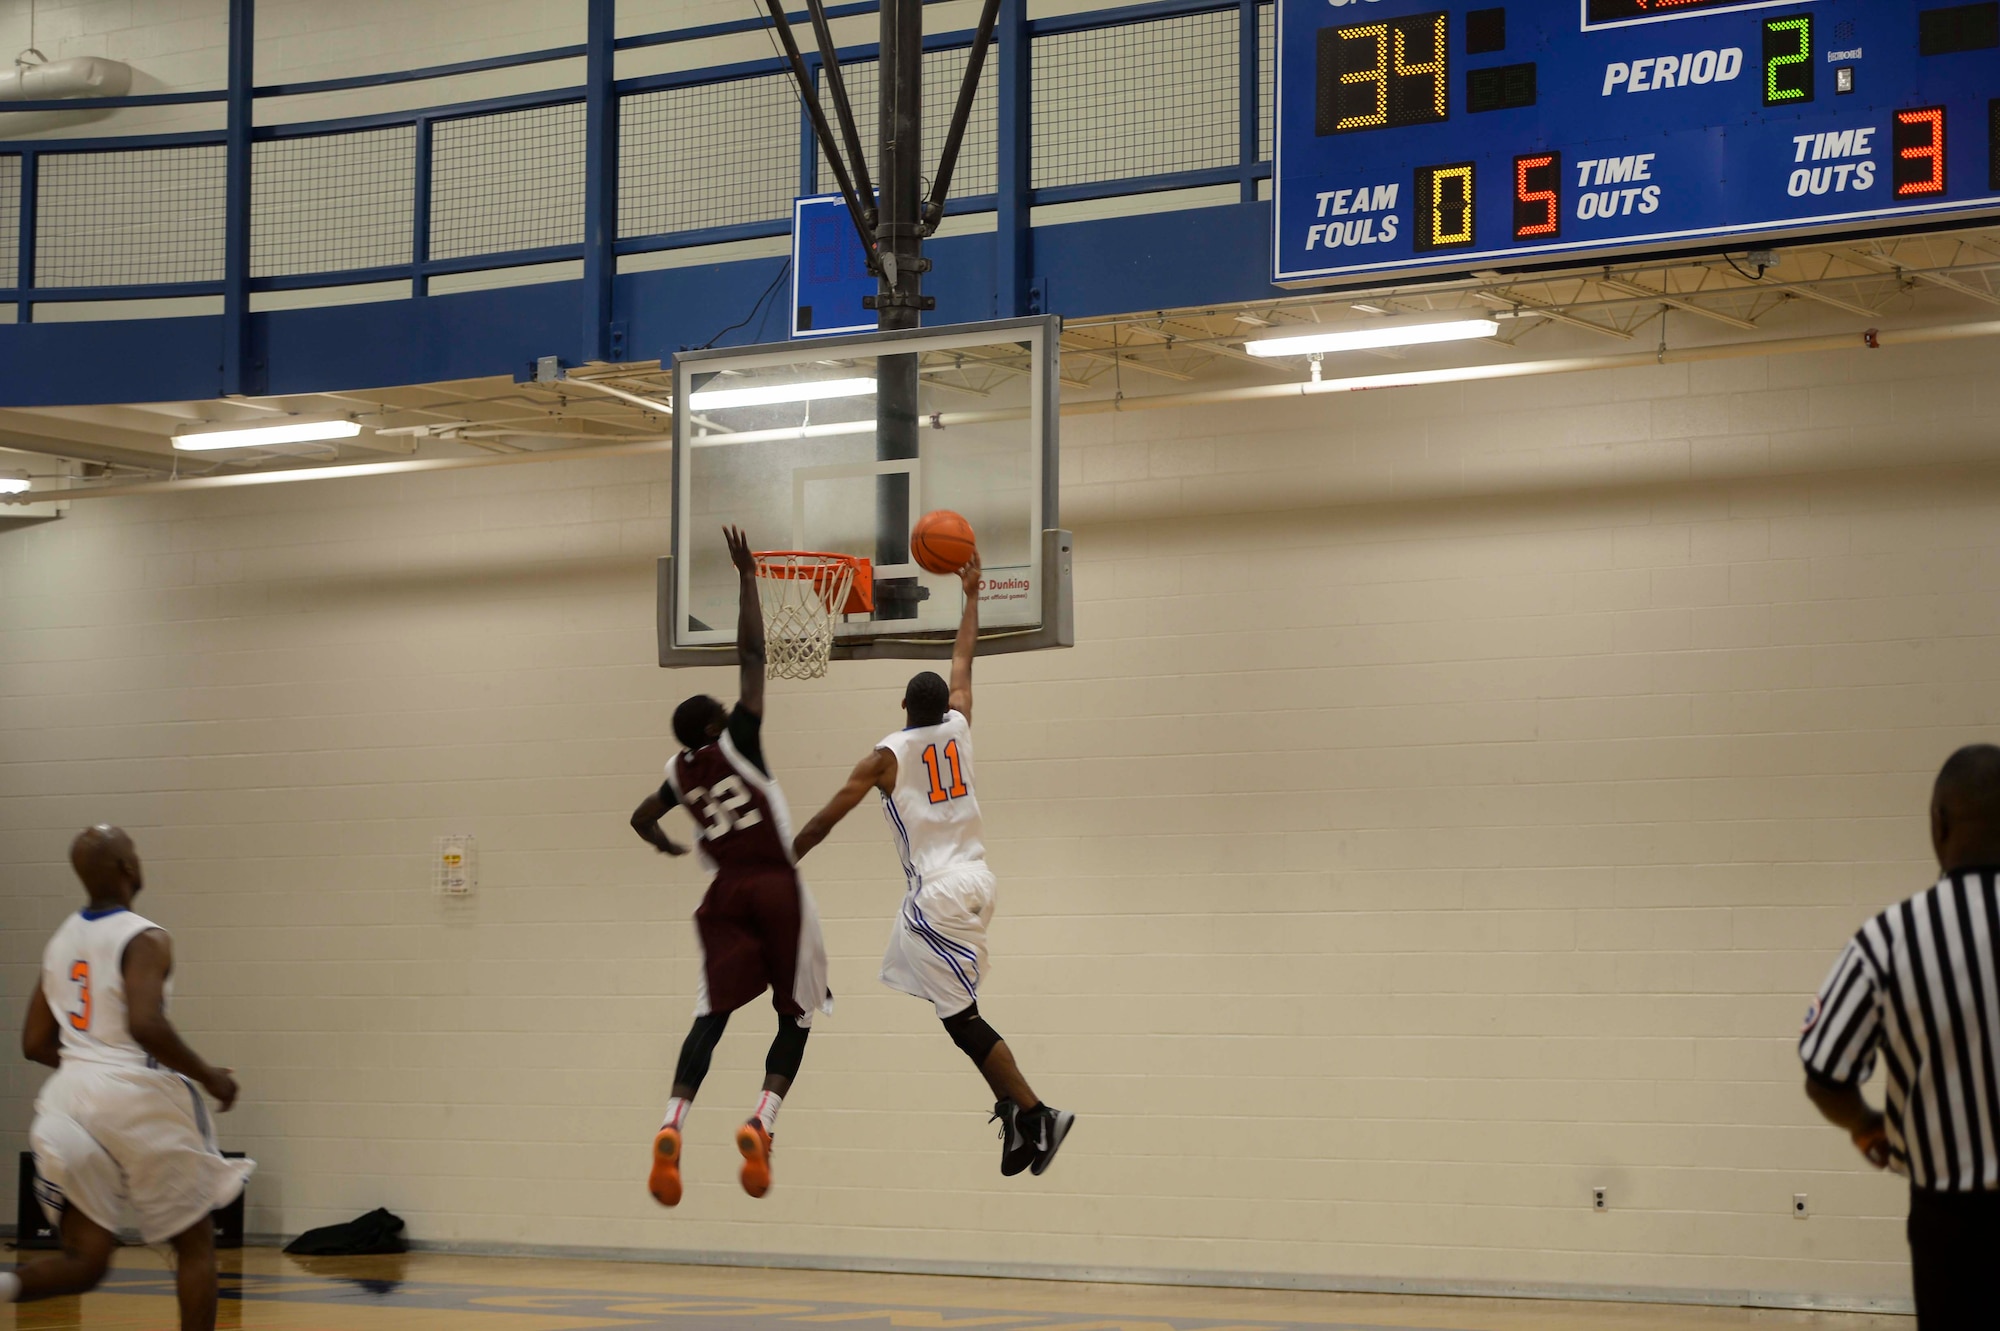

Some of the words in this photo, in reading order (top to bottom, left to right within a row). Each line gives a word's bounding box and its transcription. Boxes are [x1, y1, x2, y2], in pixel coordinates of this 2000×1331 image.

[1337, 15, 1446, 130] 34
[1601, 47, 1743, 97] PERIOD
[1767, 18, 1809, 101] 2
[1576, 153, 1656, 188] TIME
[1792, 127, 1876, 163] TIME
[1898, 109, 1943, 195] 3
[1315, 183, 1399, 218] TEAM
[1432, 166, 1472, 245] 0
[1517, 156, 1557, 236] 5
[1576, 185, 1661, 220] OUTS
[1787, 161, 1876, 197] OUTS
[1305, 215, 1399, 250] FOULS
[989, 578, 1030, 591] Dunking
[921, 739, 968, 805] 11
[684, 774, 763, 841] 32
[69, 960, 92, 1031] 3
